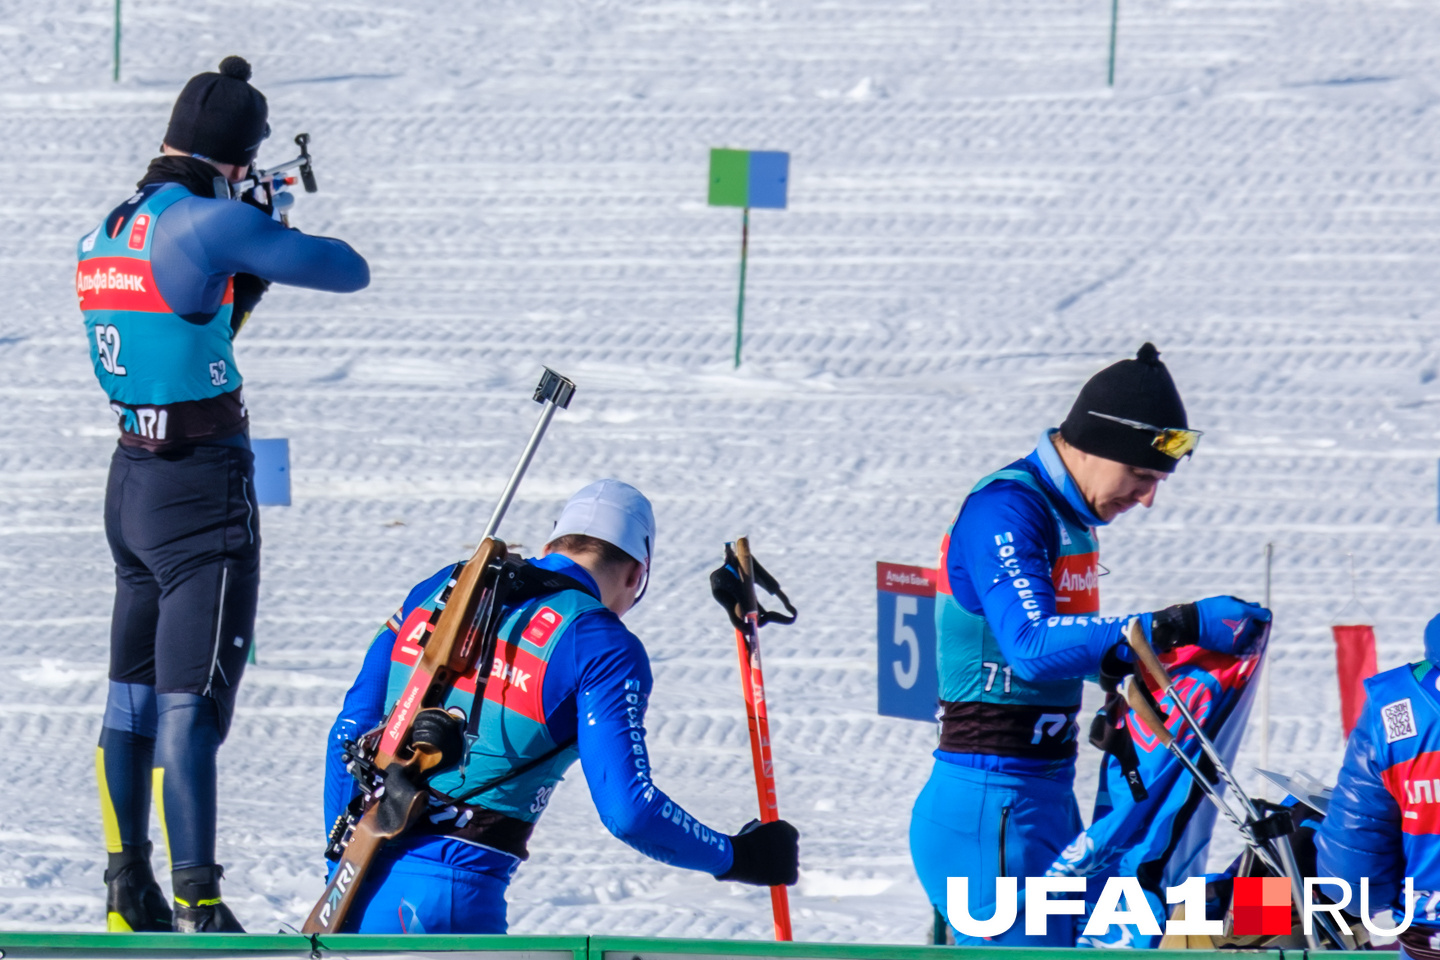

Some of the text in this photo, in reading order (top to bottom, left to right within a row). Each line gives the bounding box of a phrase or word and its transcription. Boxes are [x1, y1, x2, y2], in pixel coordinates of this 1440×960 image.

[108, 267, 146, 292] Банк
[95, 325, 127, 376] 52
[209, 360, 227, 386] 52
[886, 571, 910, 586] Альфа
[893, 595, 920, 690] 5
[489, 657, 532, 693] анк
[983, 662, 1012, 693] 71
[389, 686, 420, 740] Альфа Банк
